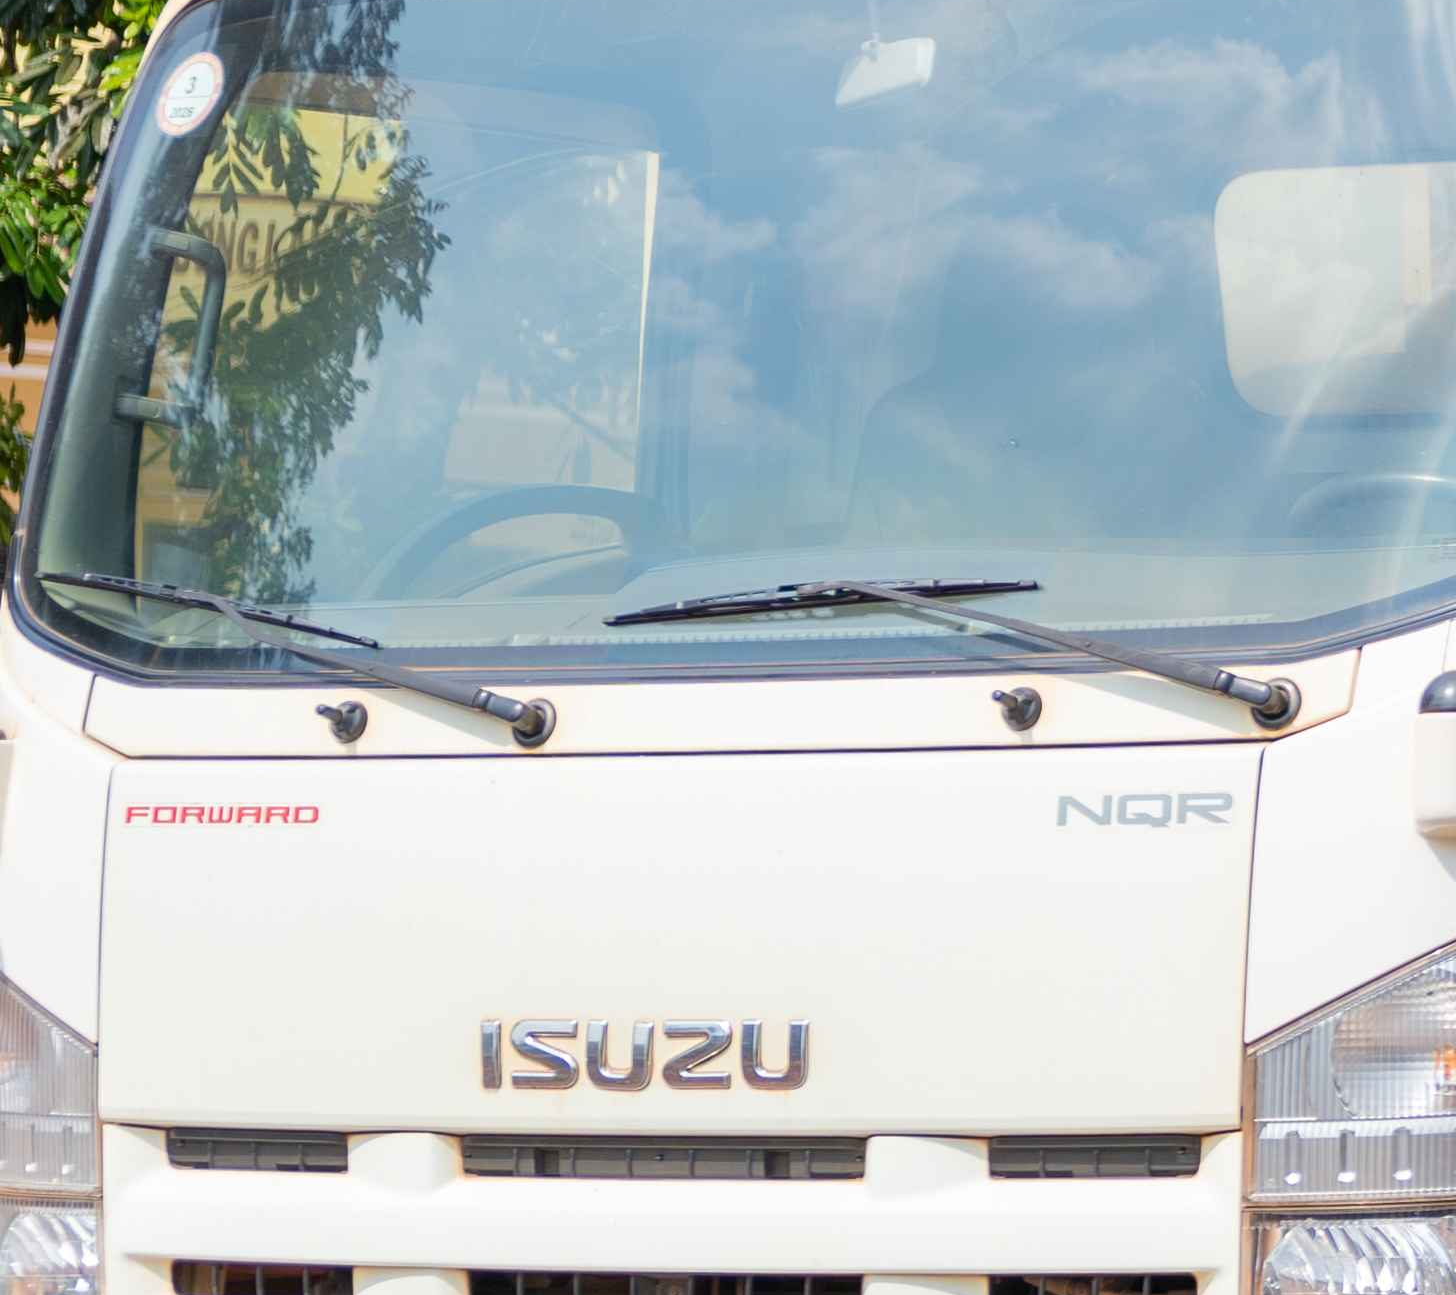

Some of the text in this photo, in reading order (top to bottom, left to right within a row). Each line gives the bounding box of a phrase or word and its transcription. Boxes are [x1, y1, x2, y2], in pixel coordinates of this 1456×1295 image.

[185, 76, 197, 95] 3
[124, 804, 320, 825] FORWARD
[1056, 792, 1233, 827] NQR
[479, 1018, 813, 1092] ISUZU
